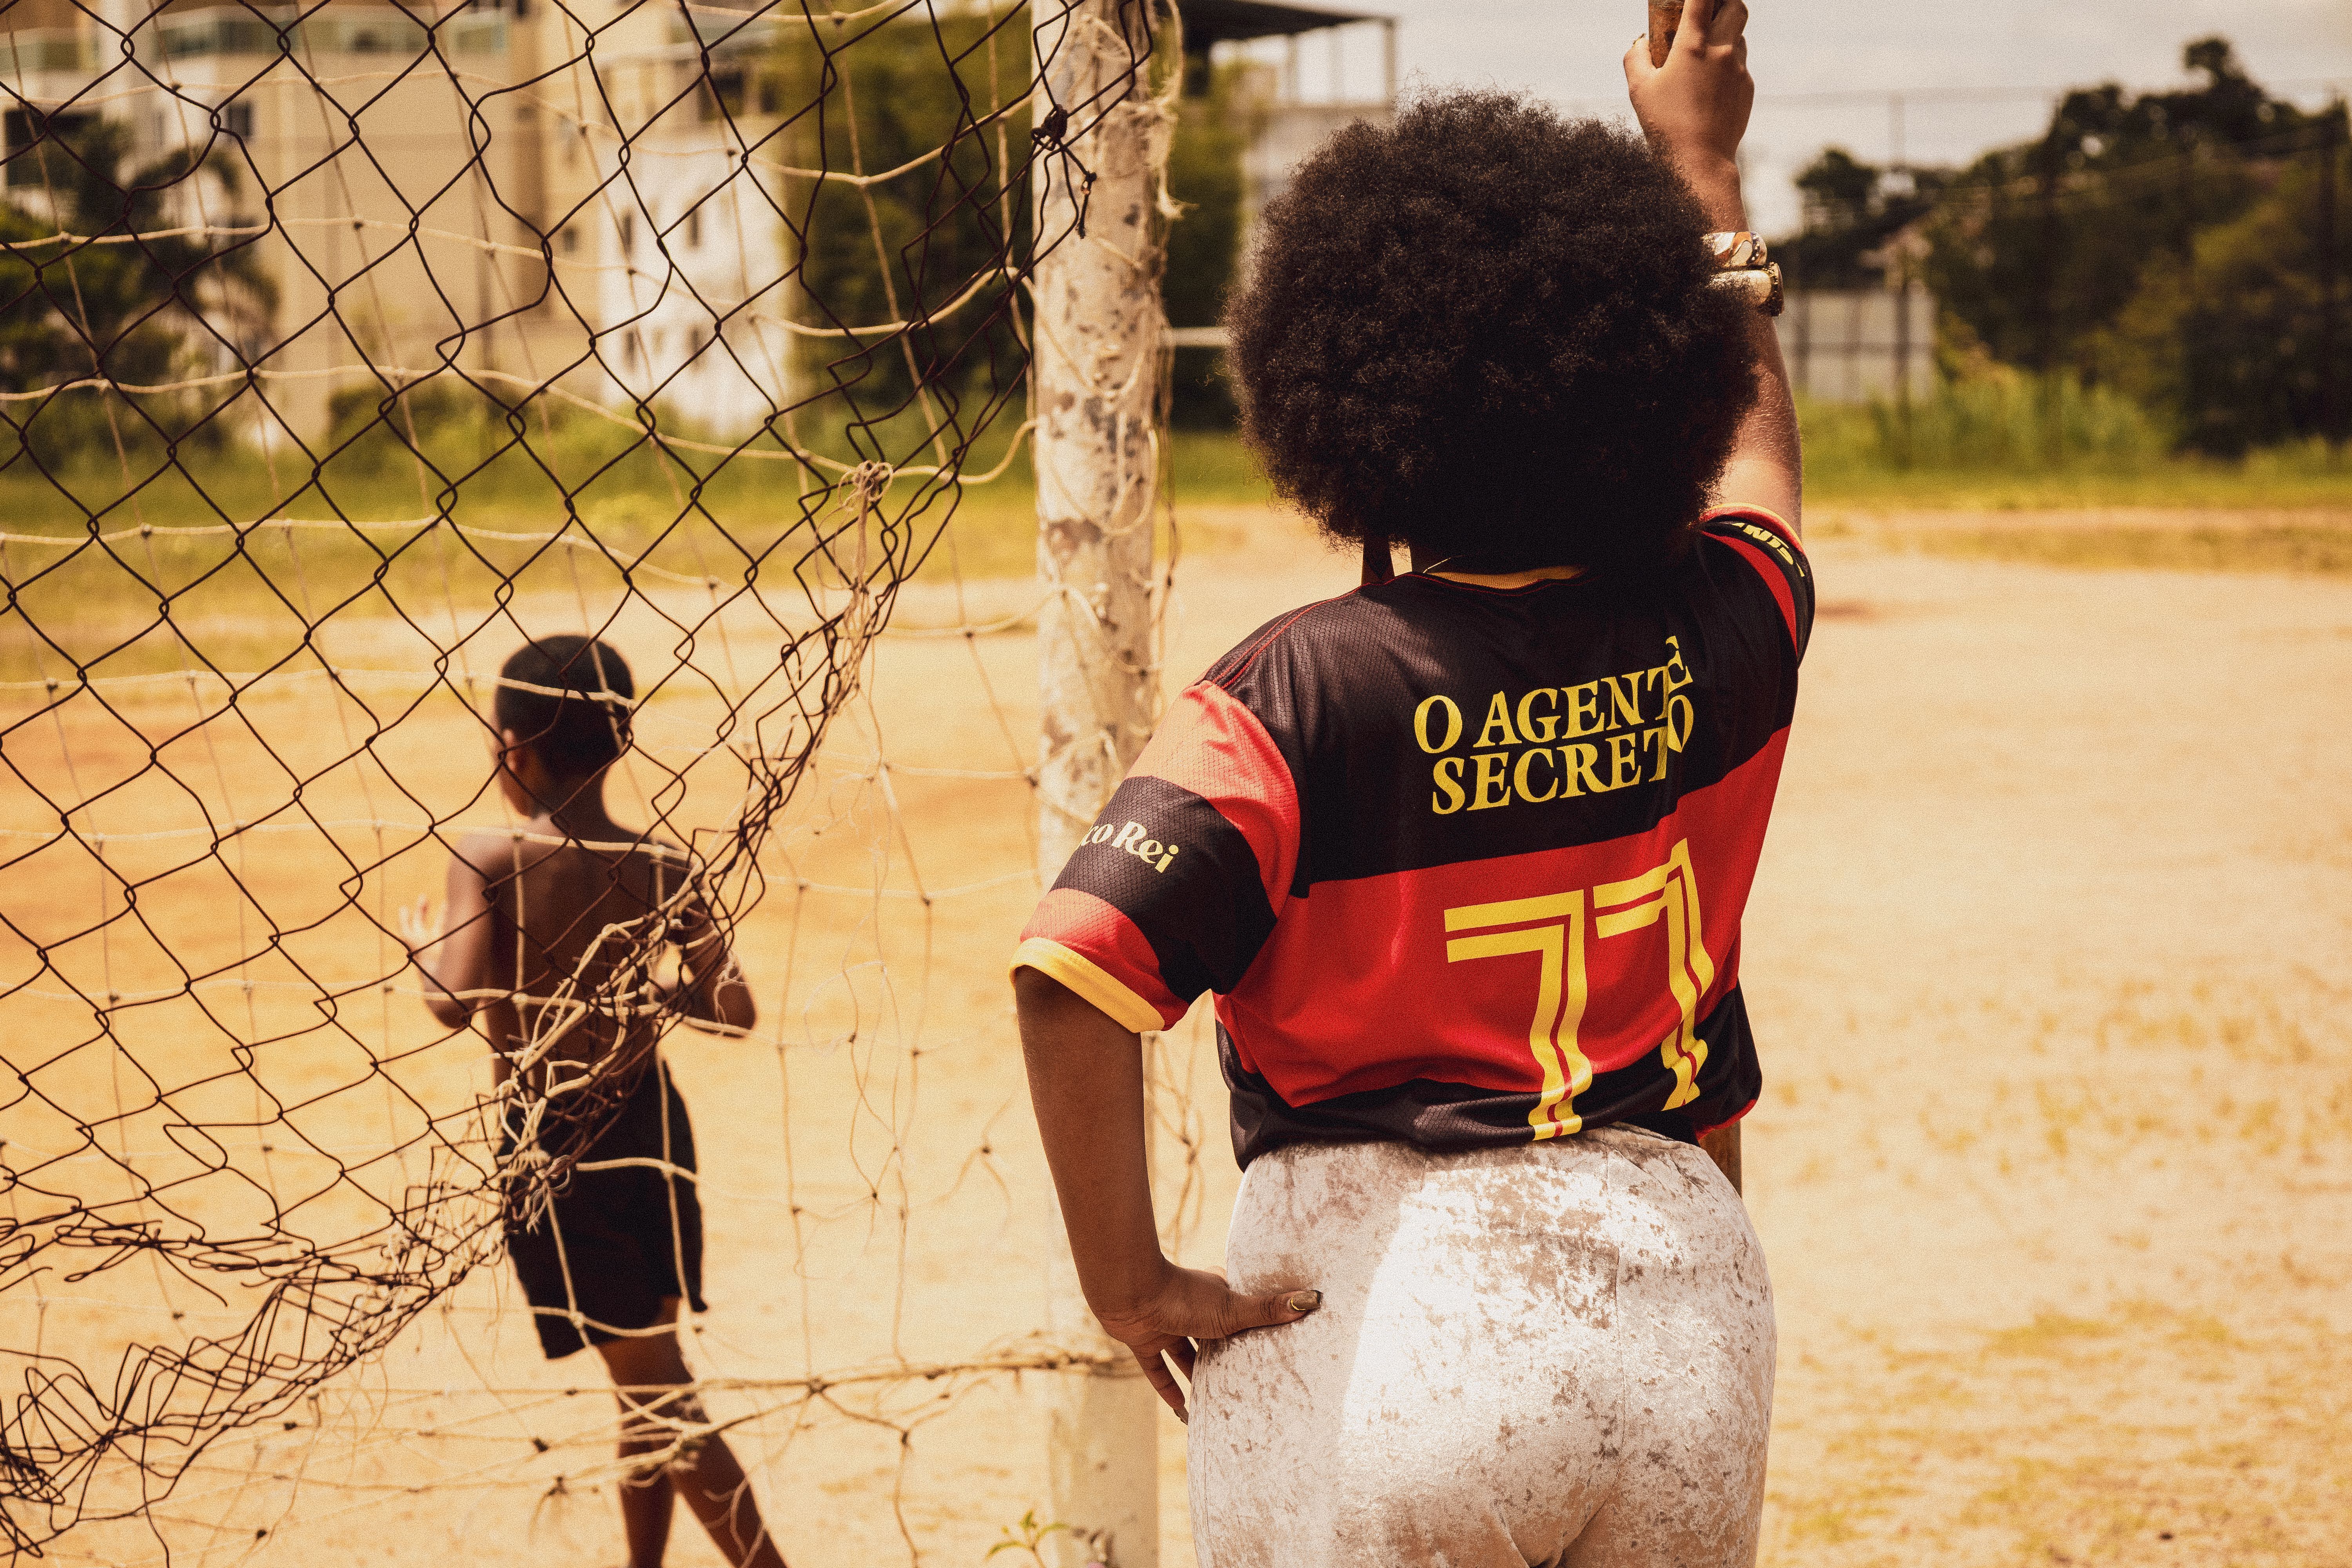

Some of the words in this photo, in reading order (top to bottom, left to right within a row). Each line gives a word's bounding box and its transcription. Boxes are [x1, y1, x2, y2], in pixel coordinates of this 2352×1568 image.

[1414, 695, 1463, 753] O
[1432, 694, 1694, 815] SECRETO
[1076, 824, 1114, 849] co
[1111, 820, 1179, 873] Rei
[1444, 837, 1715, 1141] 77
